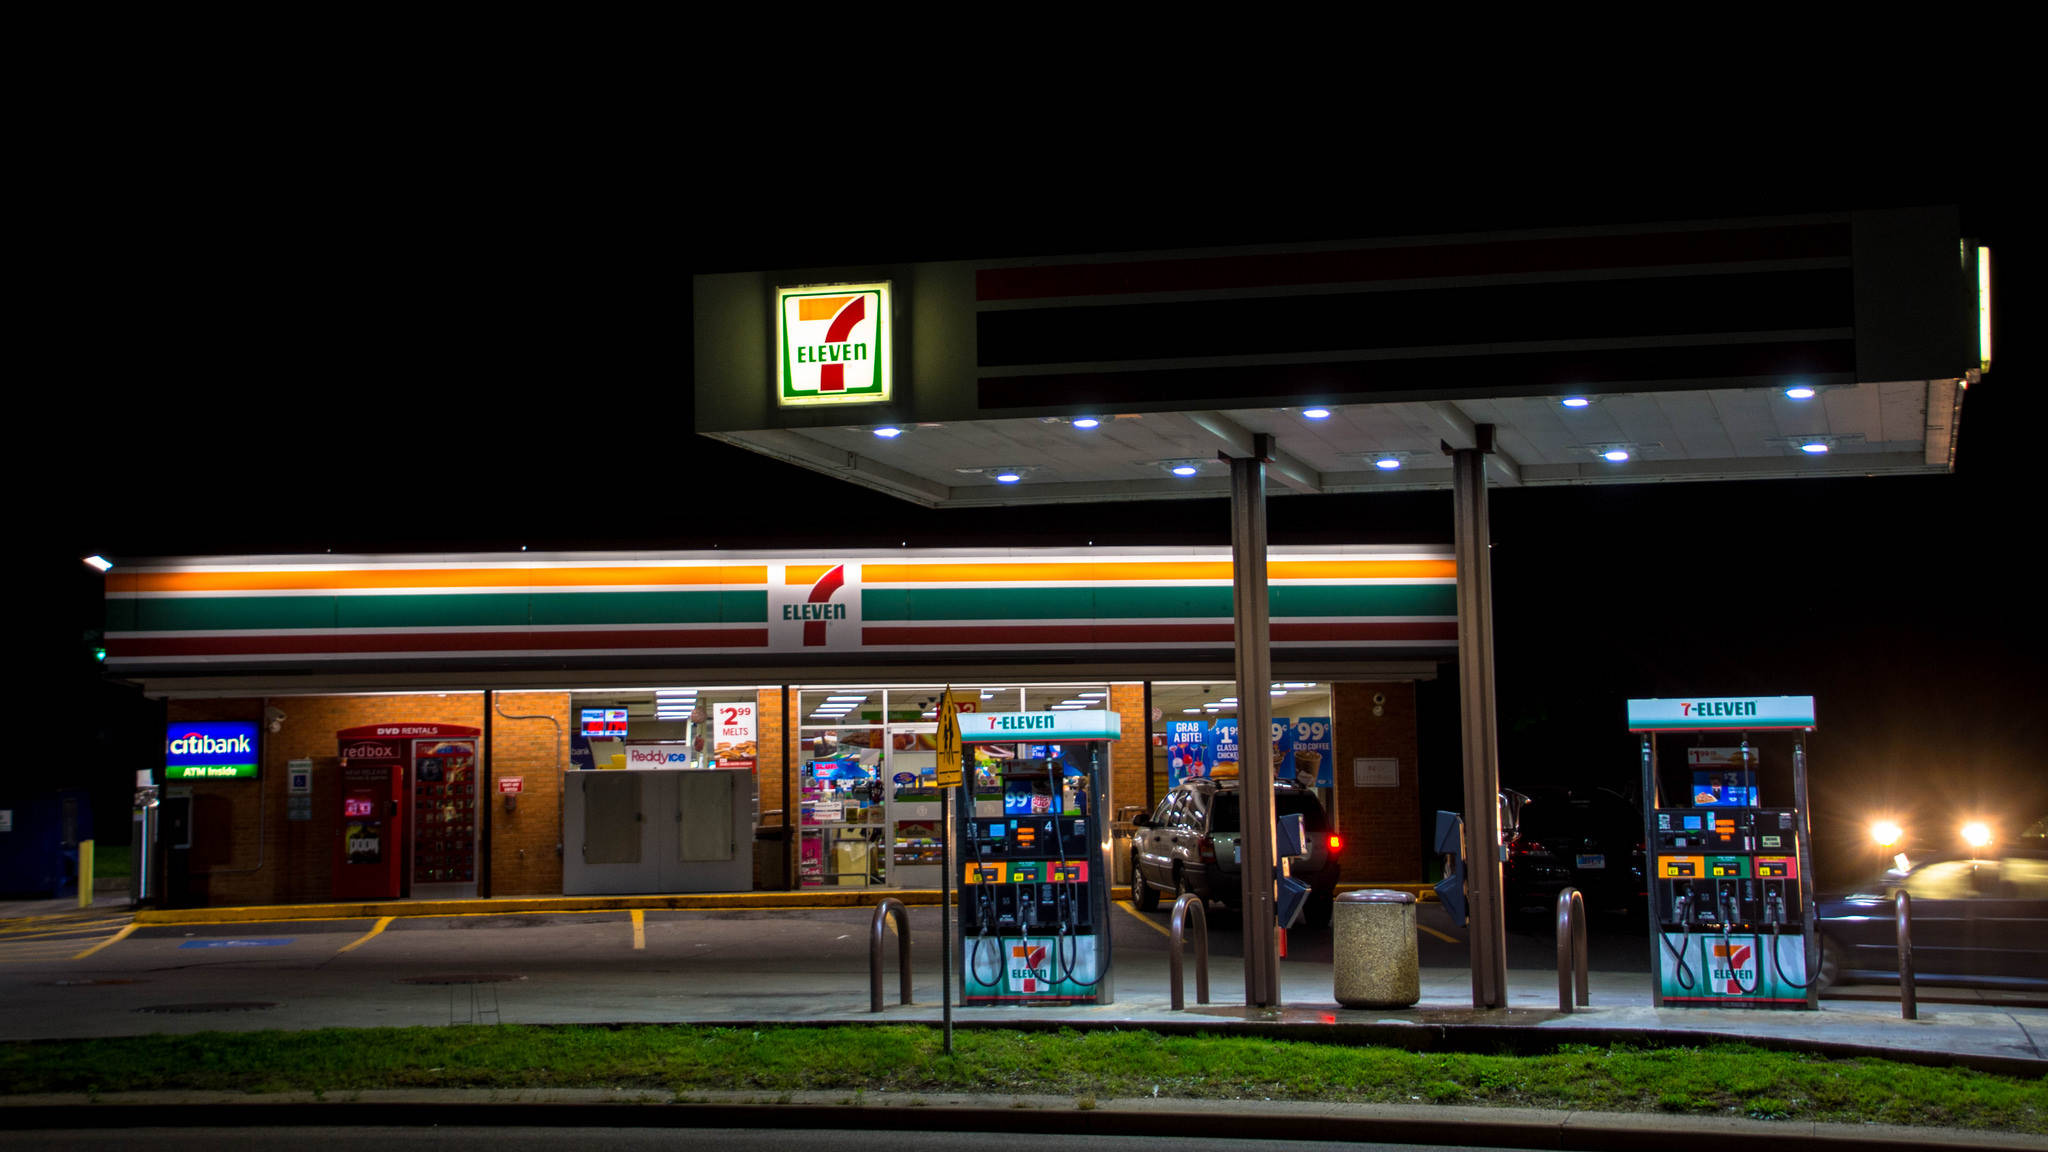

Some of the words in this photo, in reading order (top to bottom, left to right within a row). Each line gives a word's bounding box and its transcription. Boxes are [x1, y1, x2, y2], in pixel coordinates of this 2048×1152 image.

[377, 727, 400, 736] DVD
[401, 726, 439, 736] RENTALS
[722, 727, 749, 737] MELTS
[1176, 722, 1199, 733] GRAB
[1174, 733, 1180, 743] A
[1181, 732, 1202, 743] BITE!
[170, 733, 251, 755] citibank
[343, 743, 393, 758] redbox
[183, 766, 206, 777] ATM
[207, 766, 237, 777] Inside
[1044, 820, 1053, 833] 4
